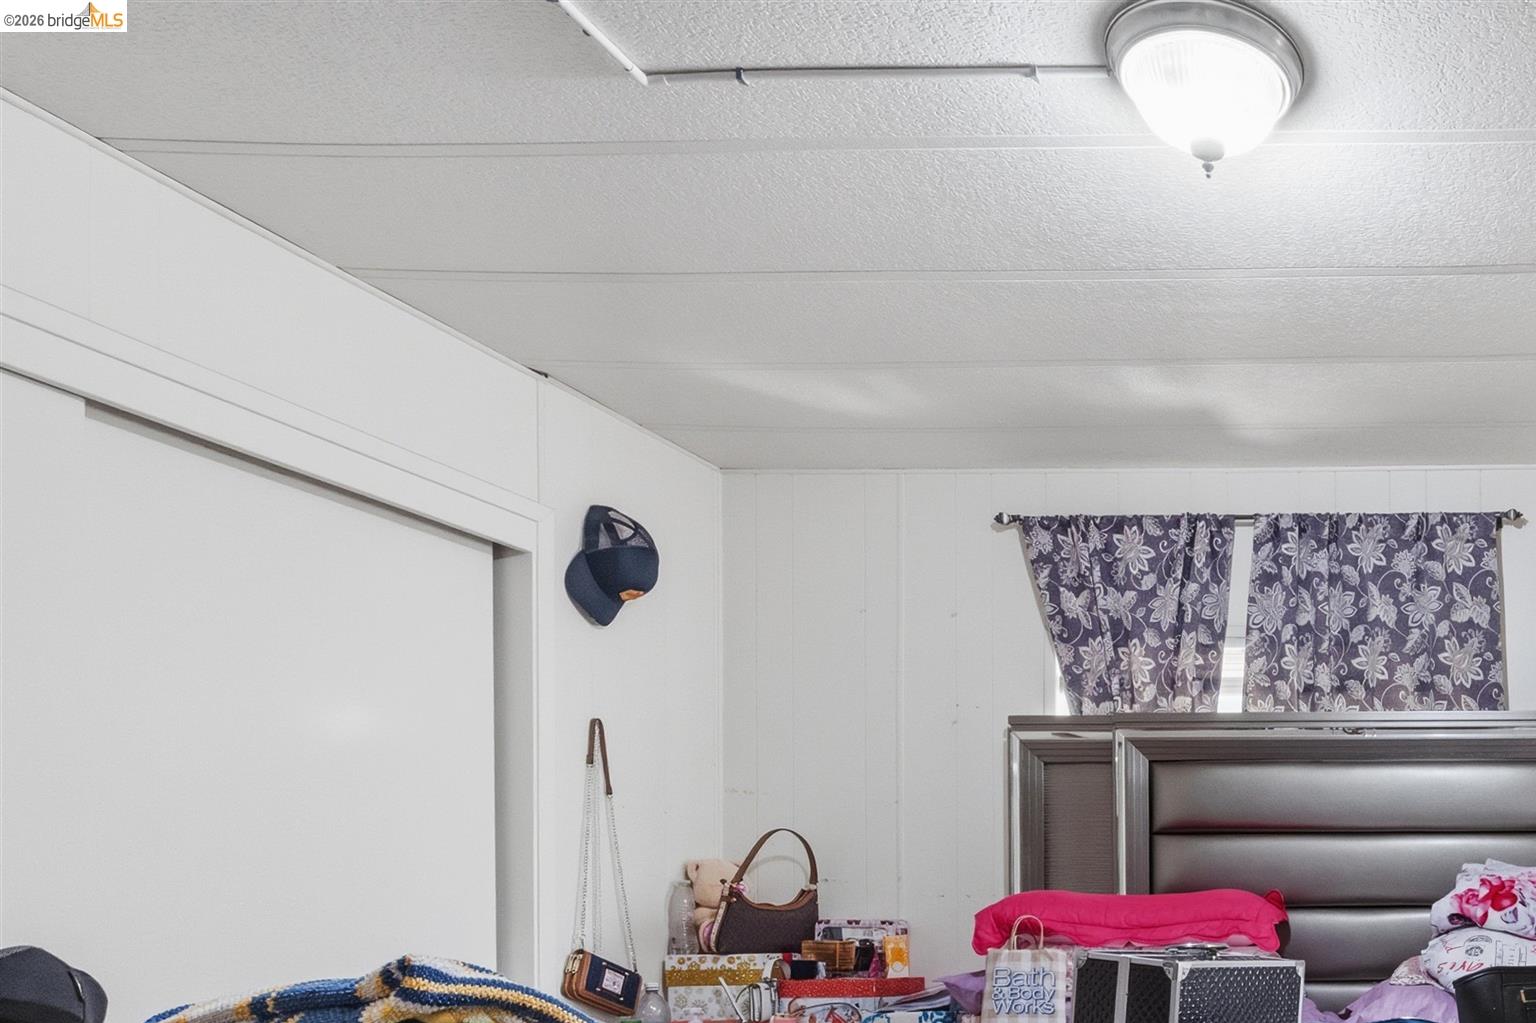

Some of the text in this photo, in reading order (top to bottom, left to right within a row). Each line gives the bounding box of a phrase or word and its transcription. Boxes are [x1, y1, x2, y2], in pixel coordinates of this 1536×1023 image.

[992, 967, 1056, 988] Bath
[991, 987, 1056, 1003] & Body
[992, 999, 1056, 1016] Works
